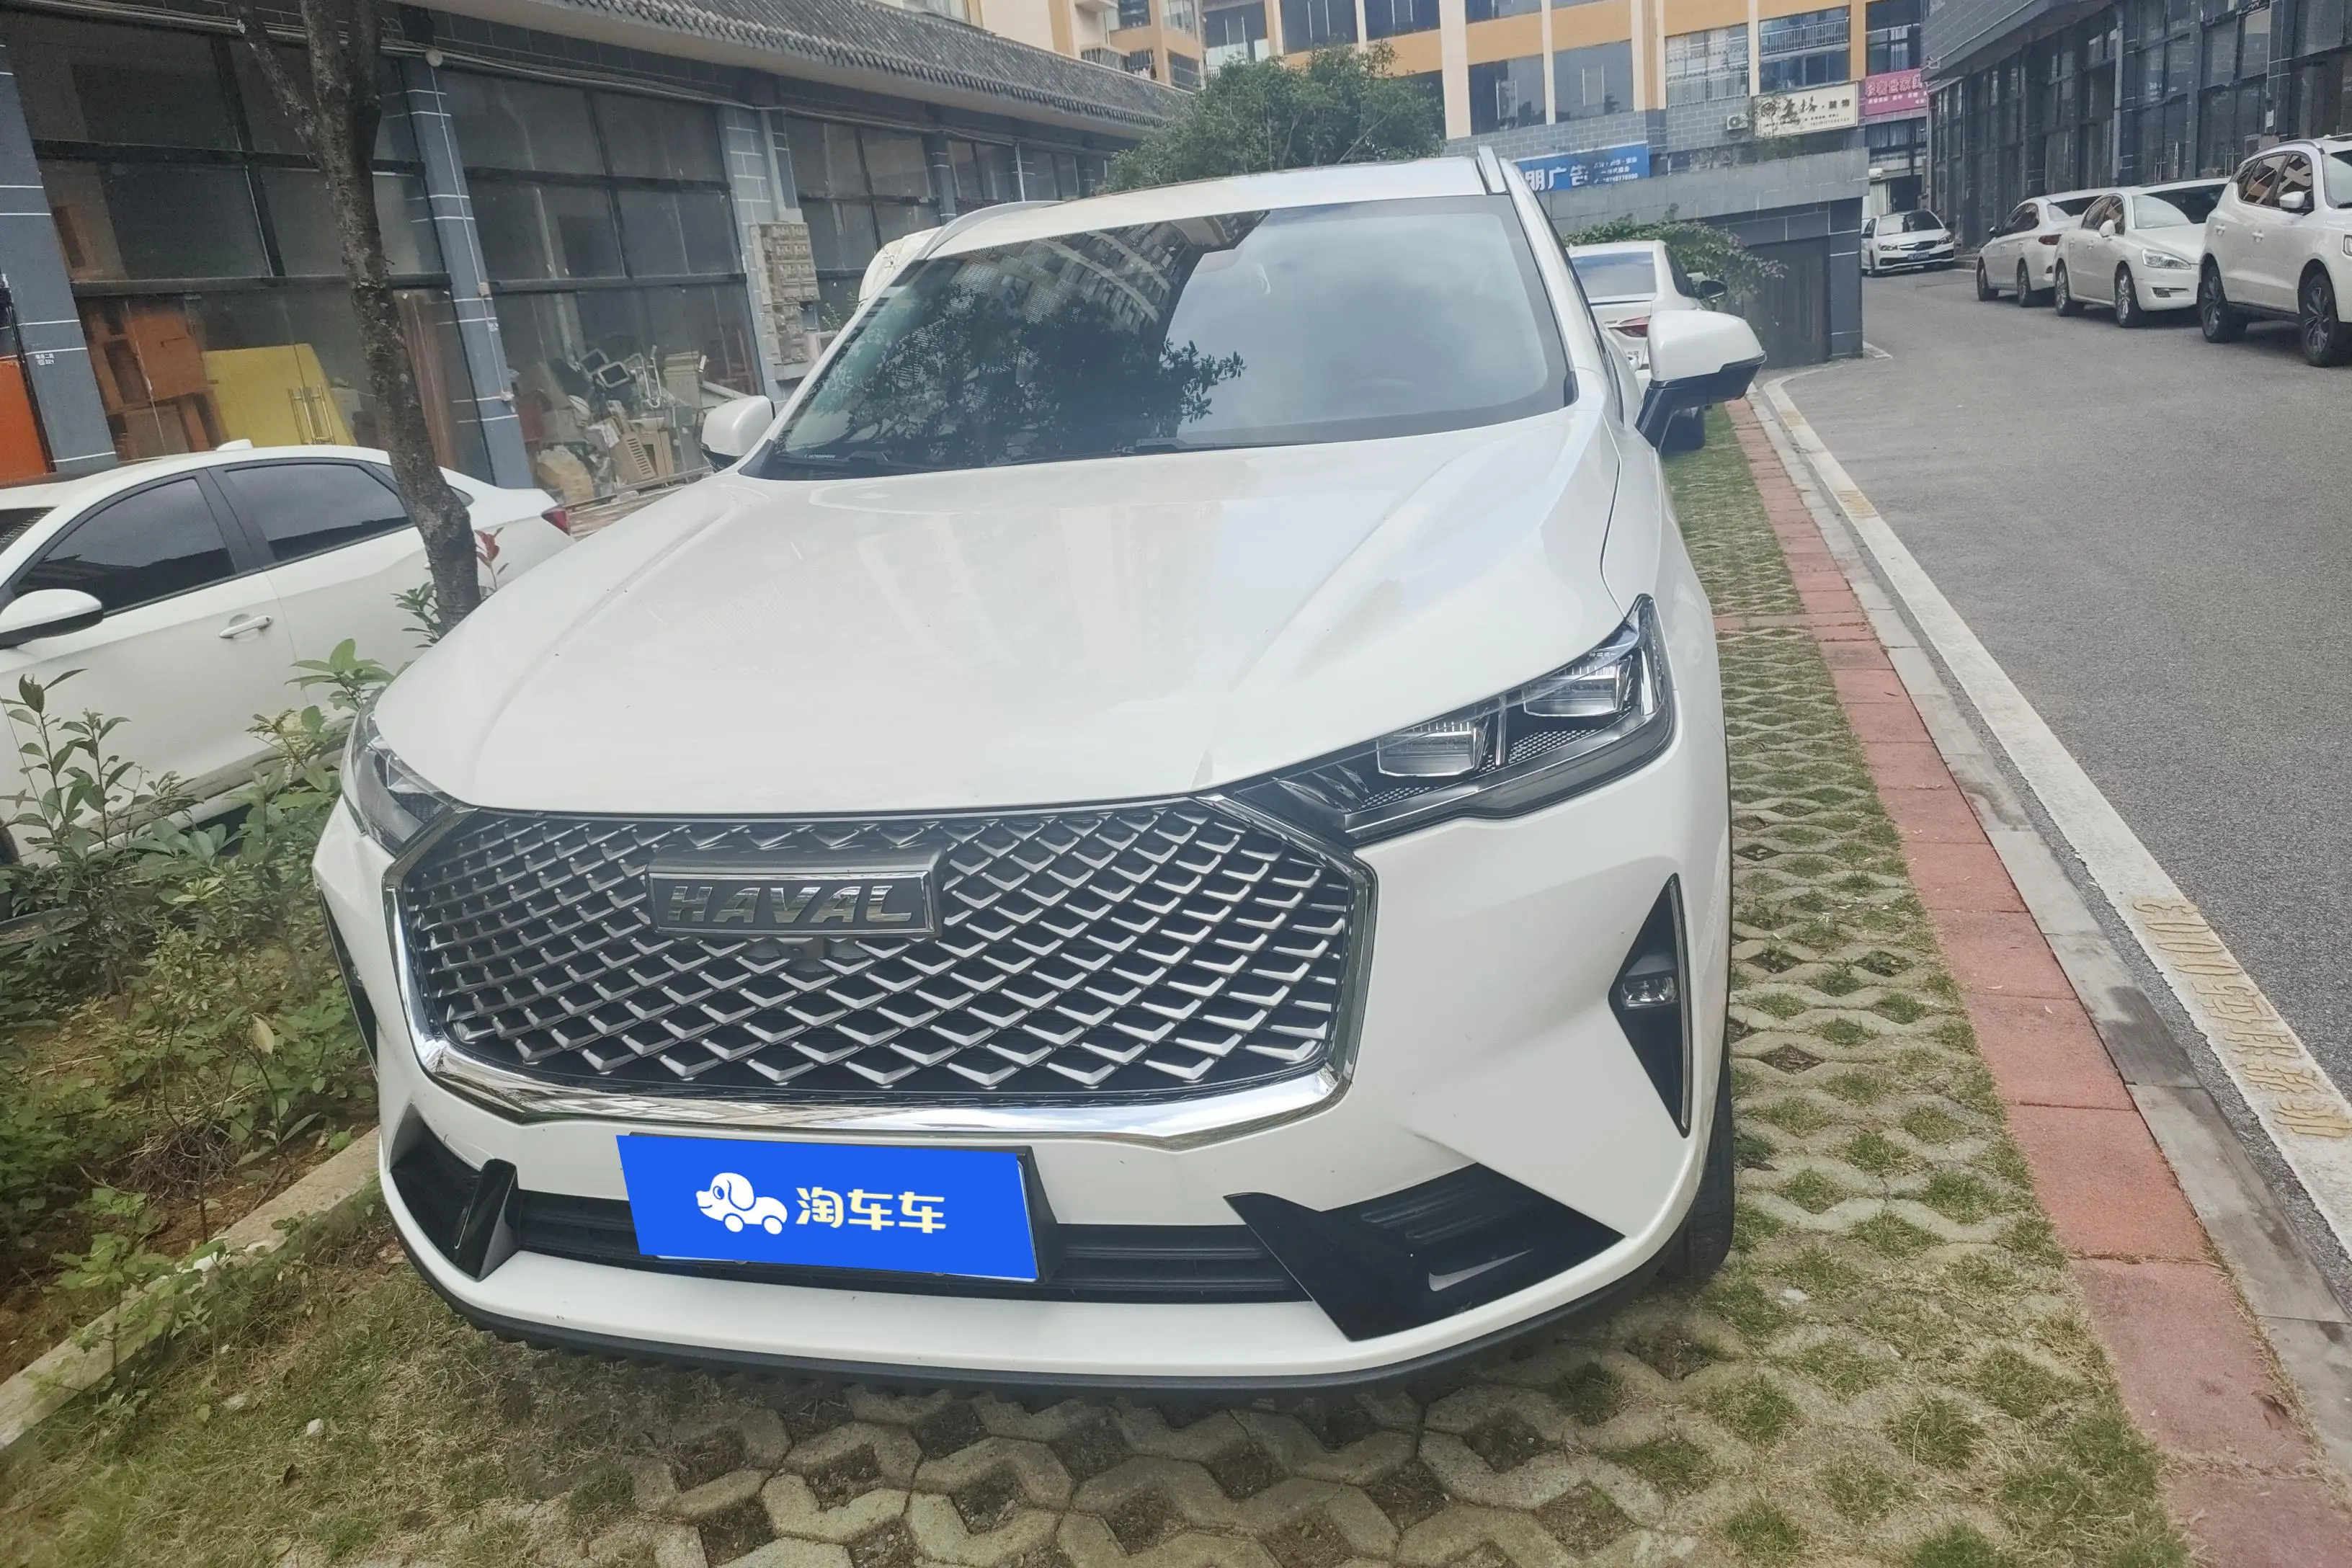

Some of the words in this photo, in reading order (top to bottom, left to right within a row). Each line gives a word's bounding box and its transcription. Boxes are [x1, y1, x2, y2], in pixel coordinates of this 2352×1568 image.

[1866, 74, 1923, 97] 世家美
[667, 885, 912, 924] HAVAL
